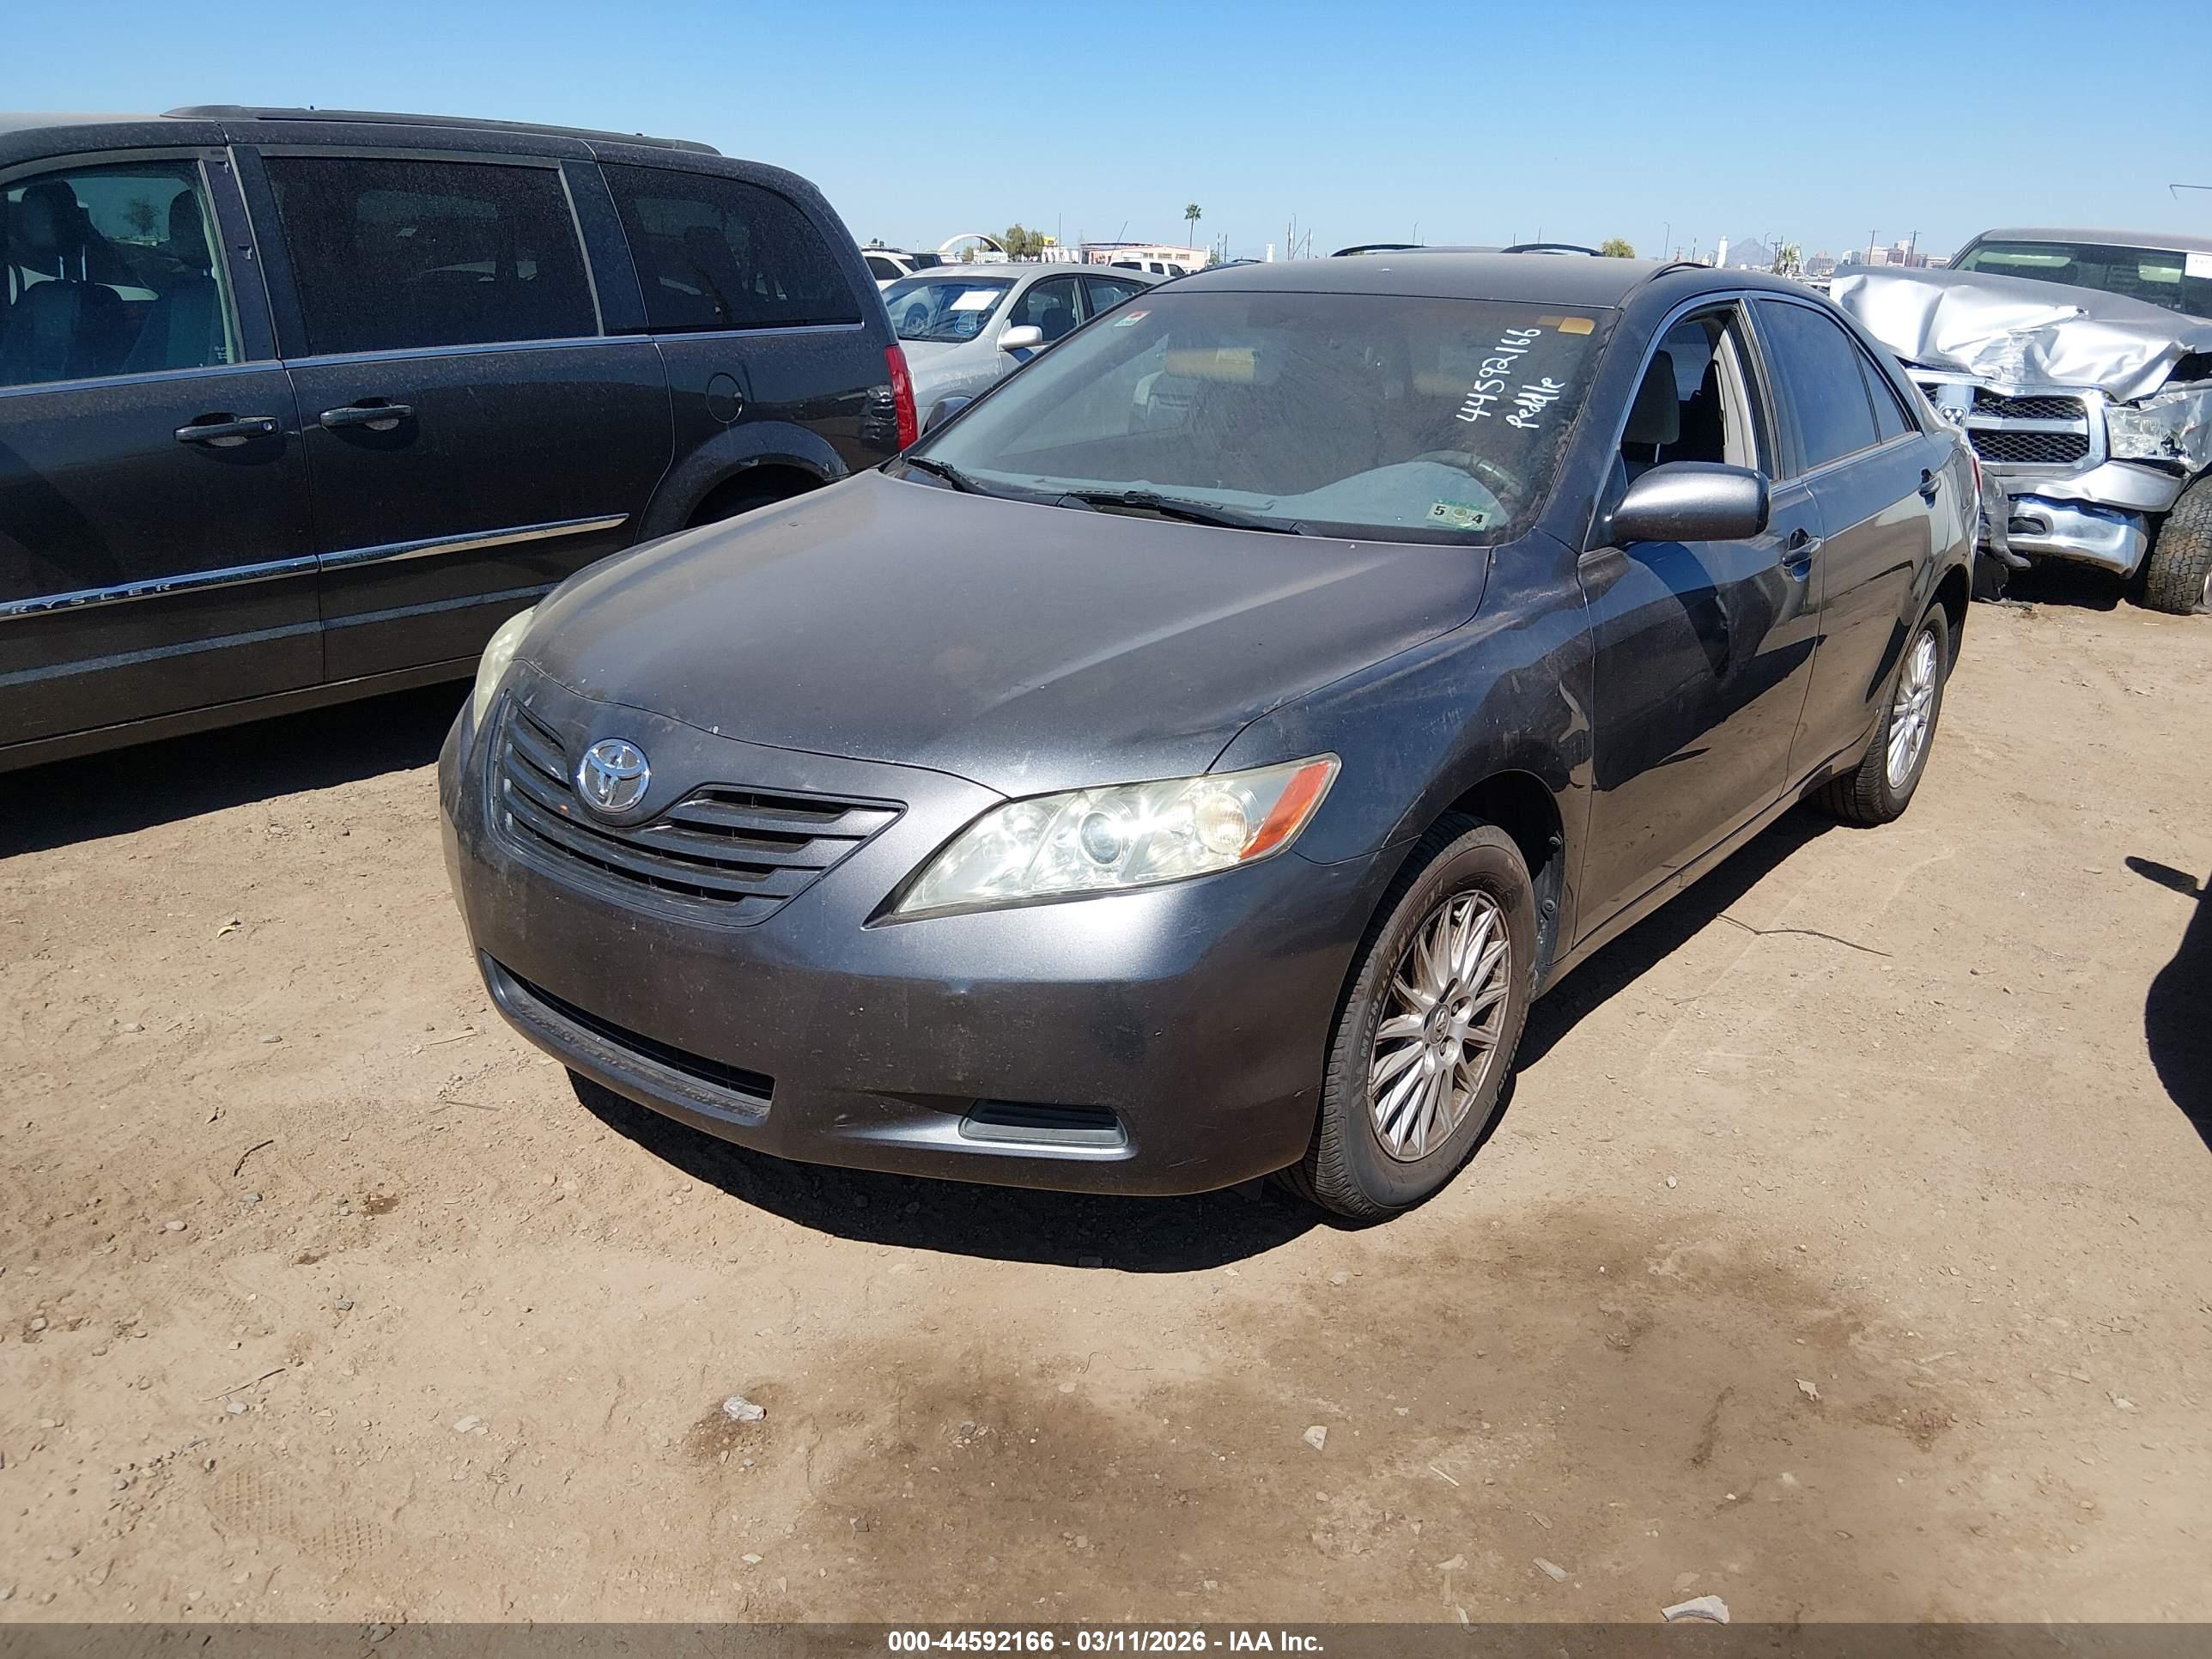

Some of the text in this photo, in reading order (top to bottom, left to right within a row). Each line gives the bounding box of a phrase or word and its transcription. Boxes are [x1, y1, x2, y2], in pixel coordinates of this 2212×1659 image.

[1456, 328, 1541, 422] 44592166
[1433, 505, 1484, 525] 5 4
